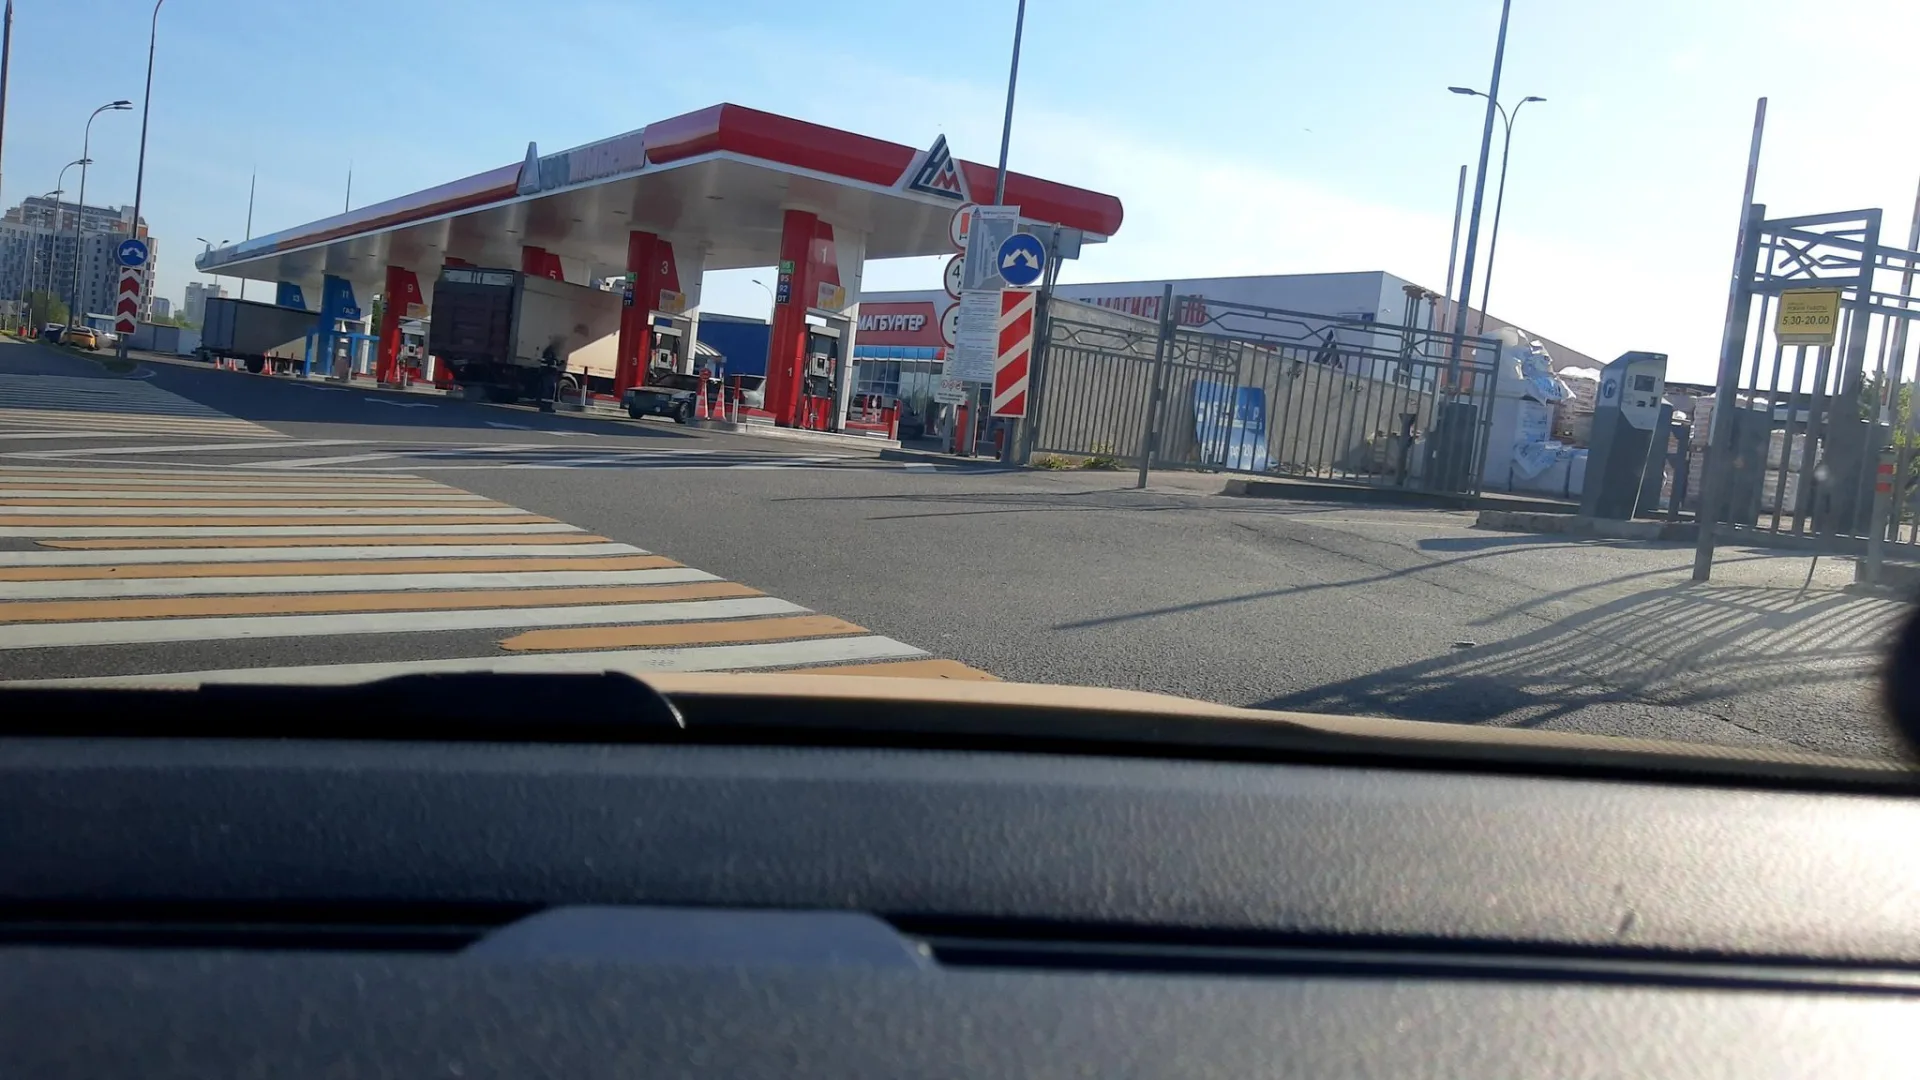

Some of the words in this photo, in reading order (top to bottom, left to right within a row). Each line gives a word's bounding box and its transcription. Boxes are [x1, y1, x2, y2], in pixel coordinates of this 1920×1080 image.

[822, 246, 828, 264] 1
[661, 261, 669, 275] 3
[407, 284, 414, 293] 9
